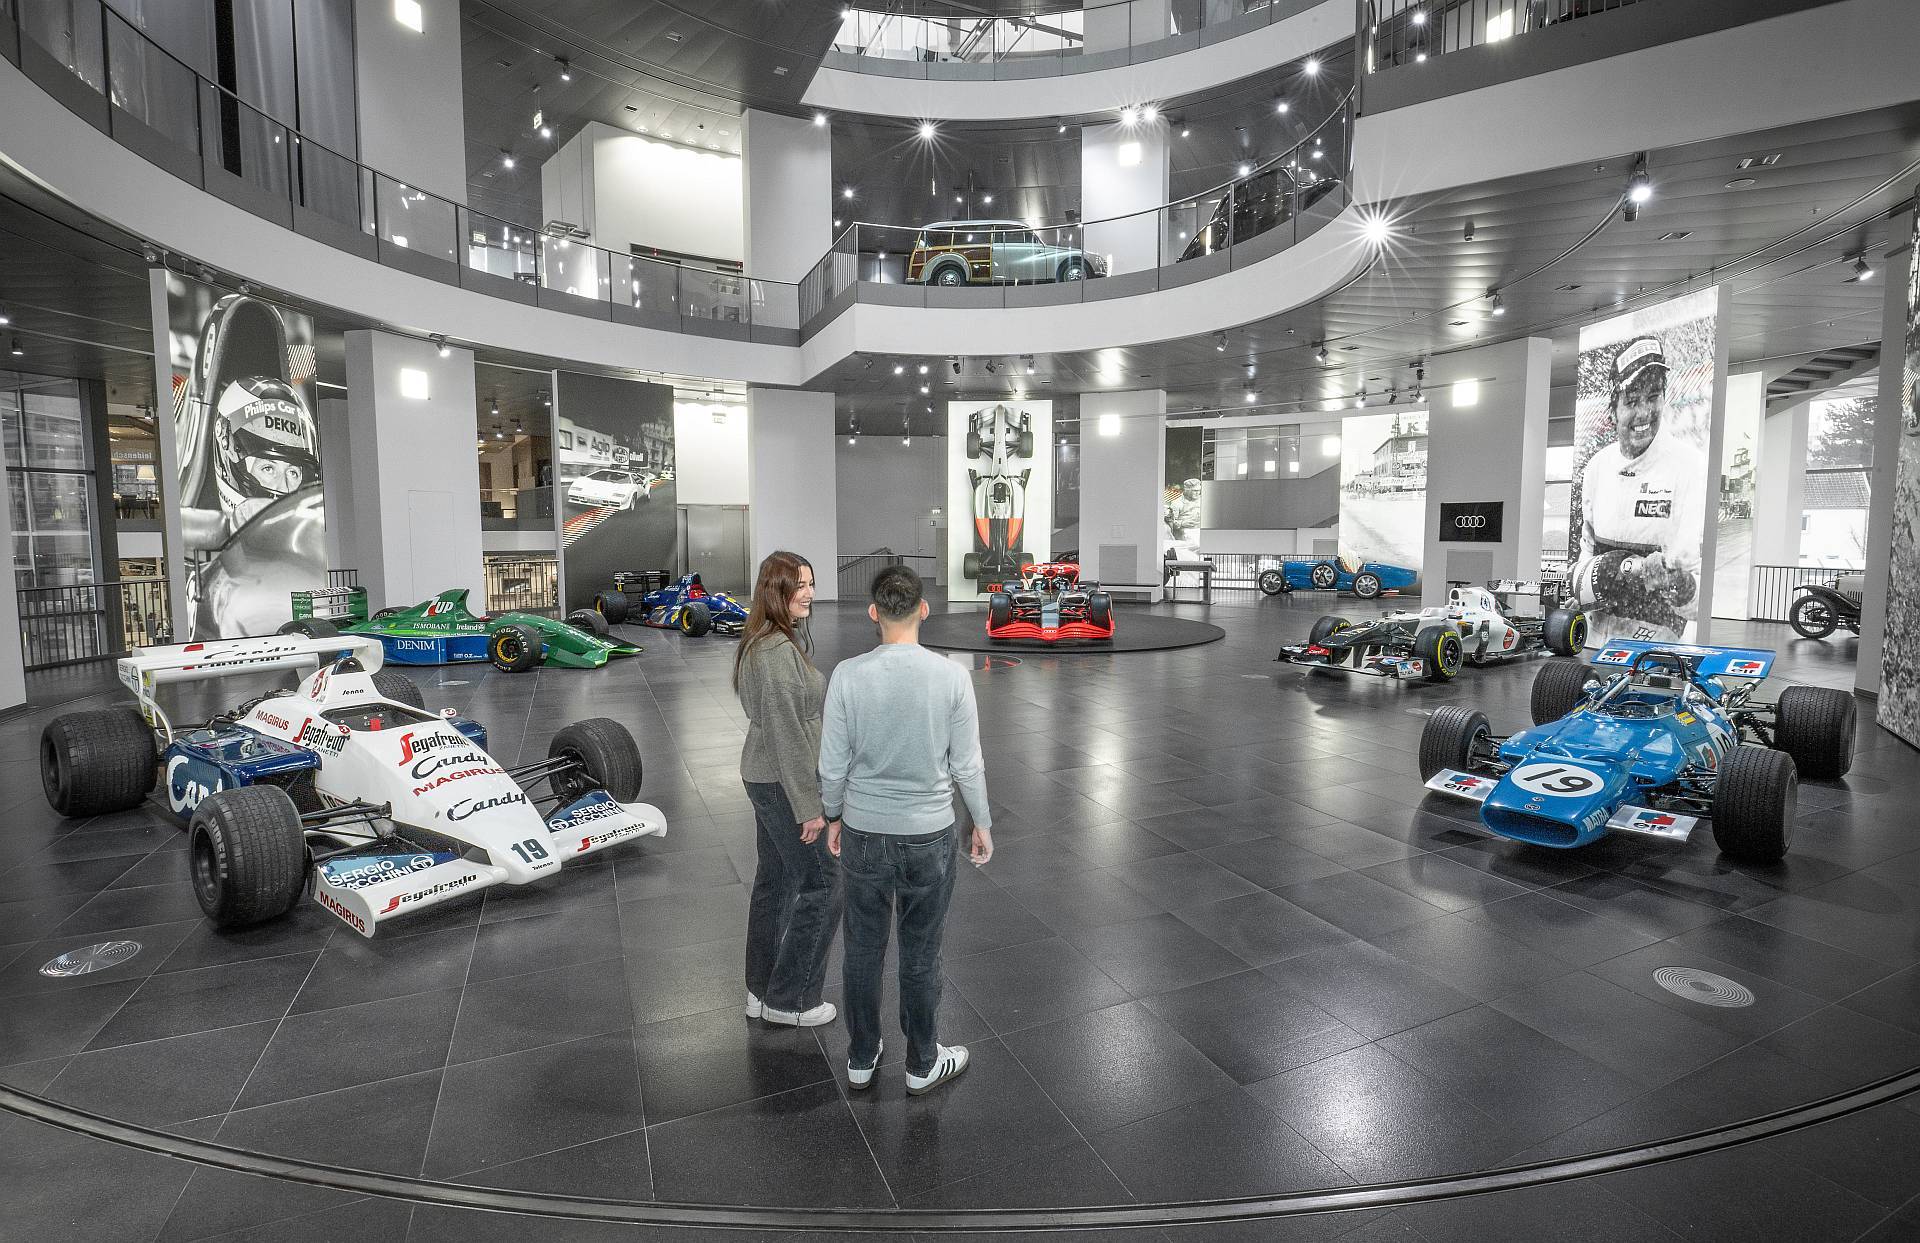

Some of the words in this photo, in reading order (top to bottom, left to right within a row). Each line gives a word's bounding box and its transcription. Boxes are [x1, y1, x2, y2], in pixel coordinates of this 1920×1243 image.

[244, 401, 276, 419] Philips
[278, 401, 296, 415] Car
[1637, 502, 1669, 517] NEC
[455, 623, 478, 631] Ireland
[396, 639, 436, 651] DENIM
[255, 709, 290, 731] MAGIRUS
[411, 752, 488, 780] Candy
[412, 767, 506, 797] MAGIRUS
[1443, 783, 1471, 793] elf
[1522, 767, 1593, 793] 19
[446, 791, 527, 822] Candy
[567, 807, 624, 828] TACCHINI
[571, 800, 616, 819] SERGIO
[1582, 806, 1610, 833] MATRA
[577, 822, 646, 852] Segafredo
[1632, 822, 1668, 832] elf
[510, 838, 549, 864] 19
[329, 860, 395, 886] SERGIO
[341, 865, 413, 891] ACCHINI
[379, 874, 477, 915] Segafredo
[319, 889, 366, 934] MAGIRUS
